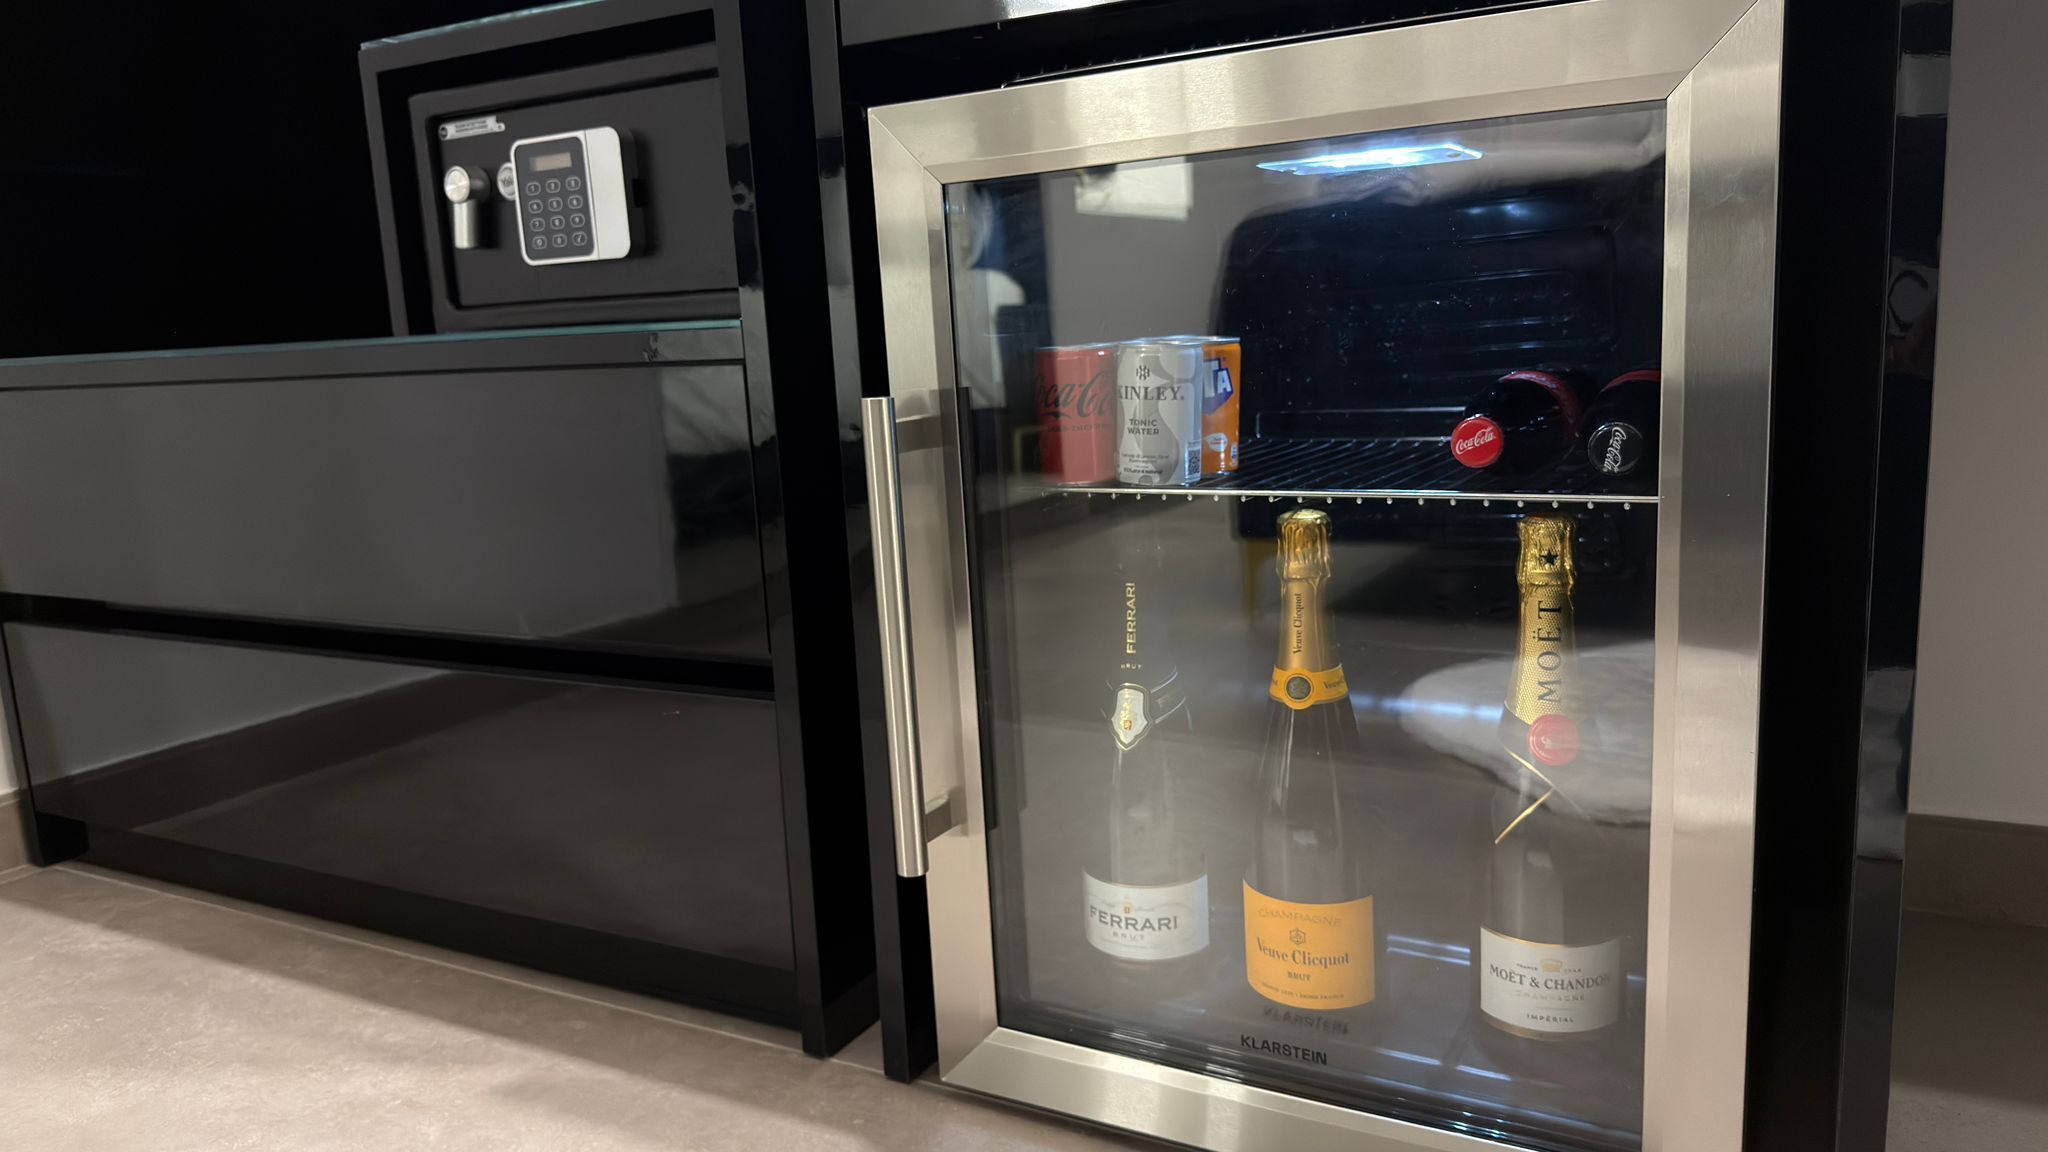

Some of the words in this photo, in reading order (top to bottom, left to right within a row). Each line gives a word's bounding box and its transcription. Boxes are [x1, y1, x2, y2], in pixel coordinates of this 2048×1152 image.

[1127, 427, 1160, 436] WATER
[1128, 418, 1158, 427] TONIC
[1455, 426, 1495, 455] Coca-Cola
[1603, 426, 1627, 473] Coca-Cola
[1126, 582, 1137, 654] FERRARI
[1293, 593, 1305, 628] Clicquot
[1293, 629, 1303, 654] Veuve
[1533, 600, 1562, 702] MOËT
[1089, 904, 1178, 931] FERRARI
[1258, 908, 1343, 926] CHAMPAGNE
[1256, 936, 1289, 962] Veuve
[1291, 949, 1350, 970] Clicquot
[1287, 971, 1311, 981] BRUT
[1490, 964, 1526, 985] MOËT
[1529, 976, 1541, 989] &
[1240, 1034, 1328, 1065] KLARSTEIN
